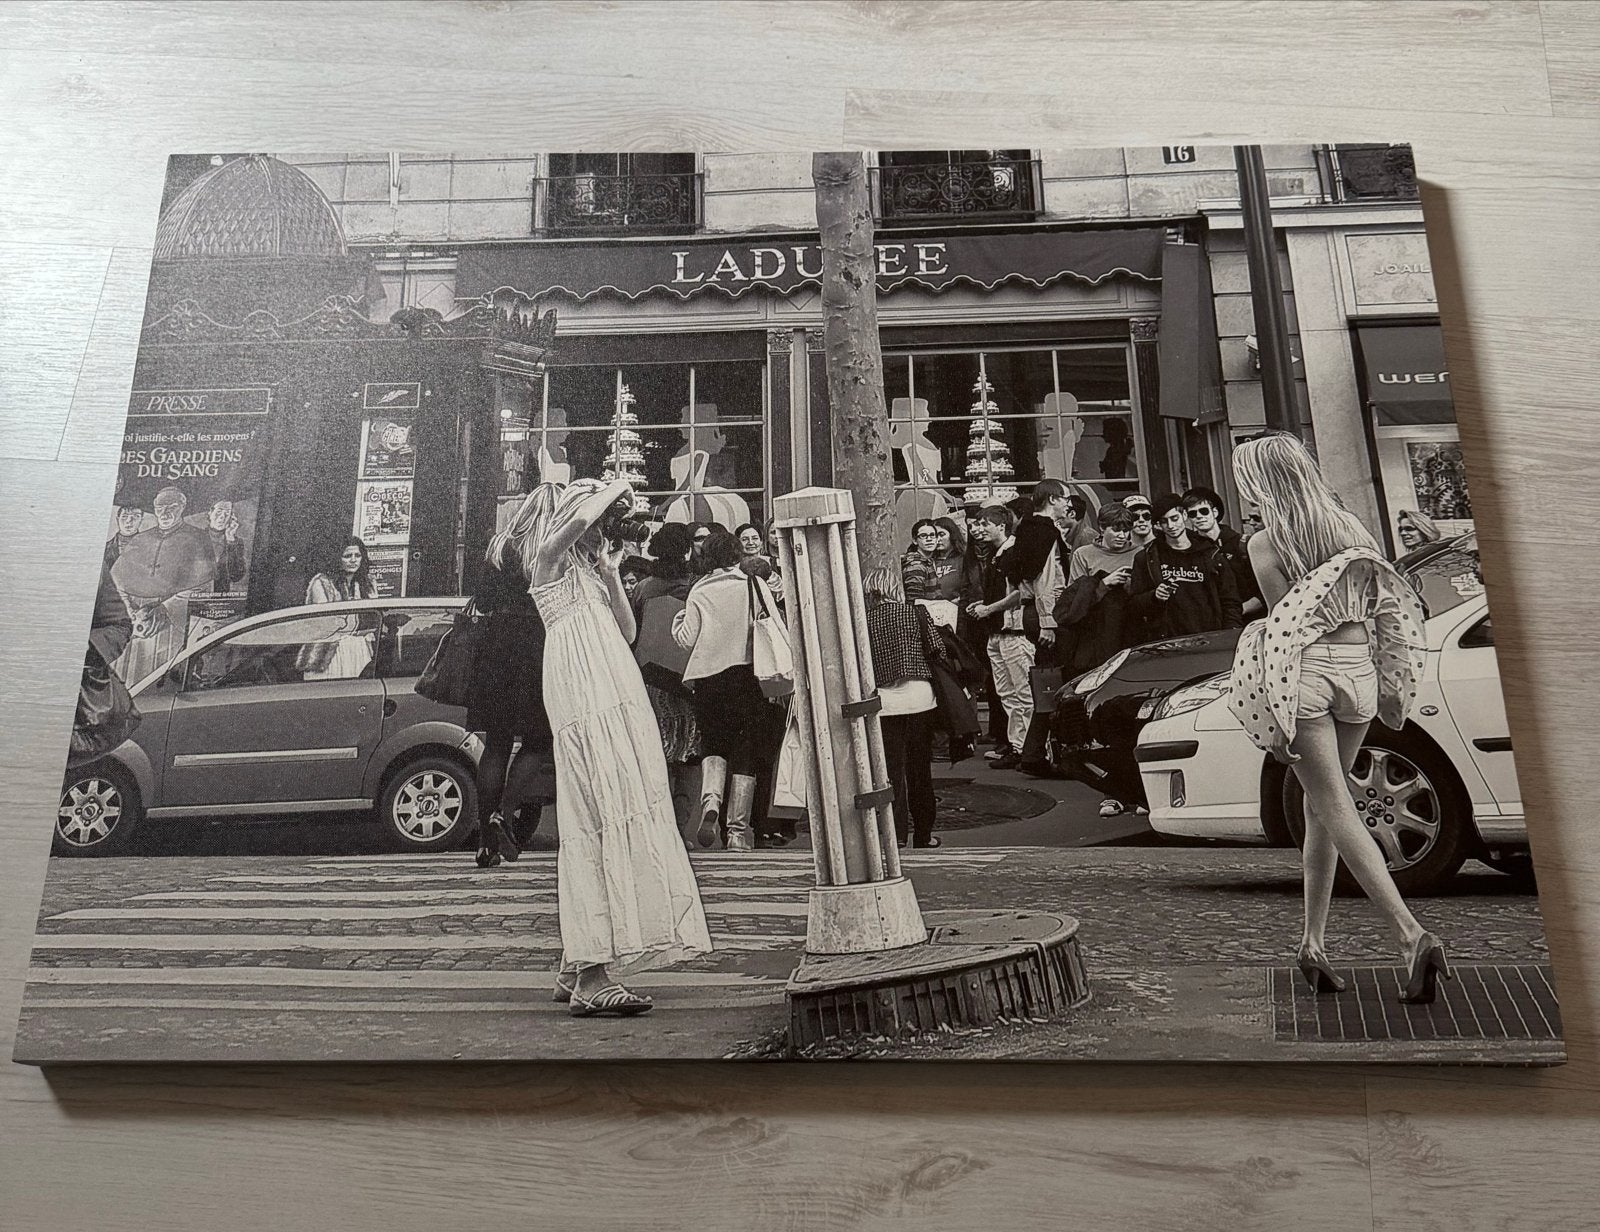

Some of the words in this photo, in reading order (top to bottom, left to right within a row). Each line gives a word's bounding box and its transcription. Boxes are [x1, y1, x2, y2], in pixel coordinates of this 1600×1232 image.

[1169, 145, 1190, 162] 16
[671, 242, 949, 283] LADUEE
[146, 395, 208, 413] PRESSE
[197, 432, 211, 442] les
[150, 447, 243, 464] GARDIENS
[137, 464, 162, 478] DU
[166, 463, 219, 480] SANG
